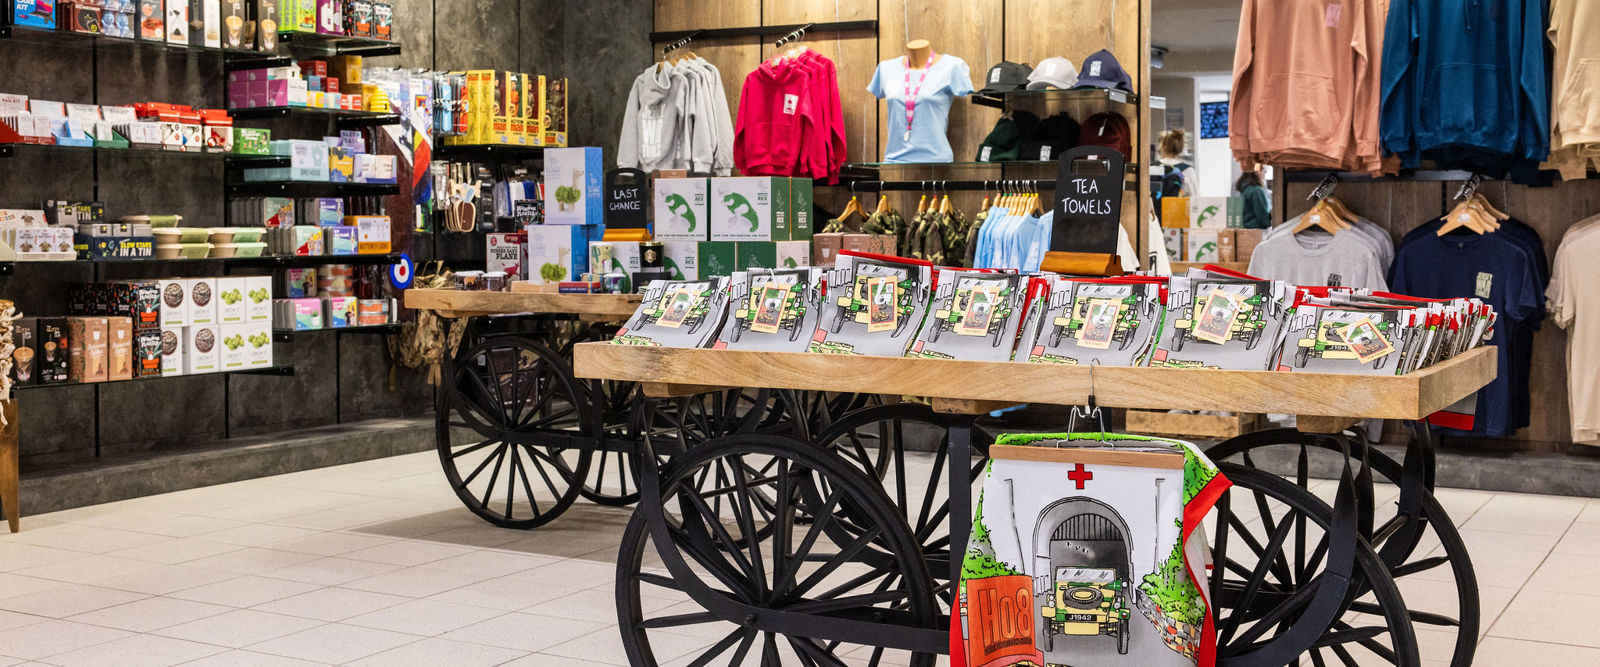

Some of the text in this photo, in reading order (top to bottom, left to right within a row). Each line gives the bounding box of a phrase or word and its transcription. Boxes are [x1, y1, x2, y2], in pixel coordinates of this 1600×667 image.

[16, 3, 29, 11] KIT
[1071, 178, 1098, 194] TEA
[613, 188, 638, 200] LAST
[609, 200, 641, 211] CHANCE
[1061, 197, 1111, 215] TOWELS
[120, 248, 152, 257] IN A TIN
